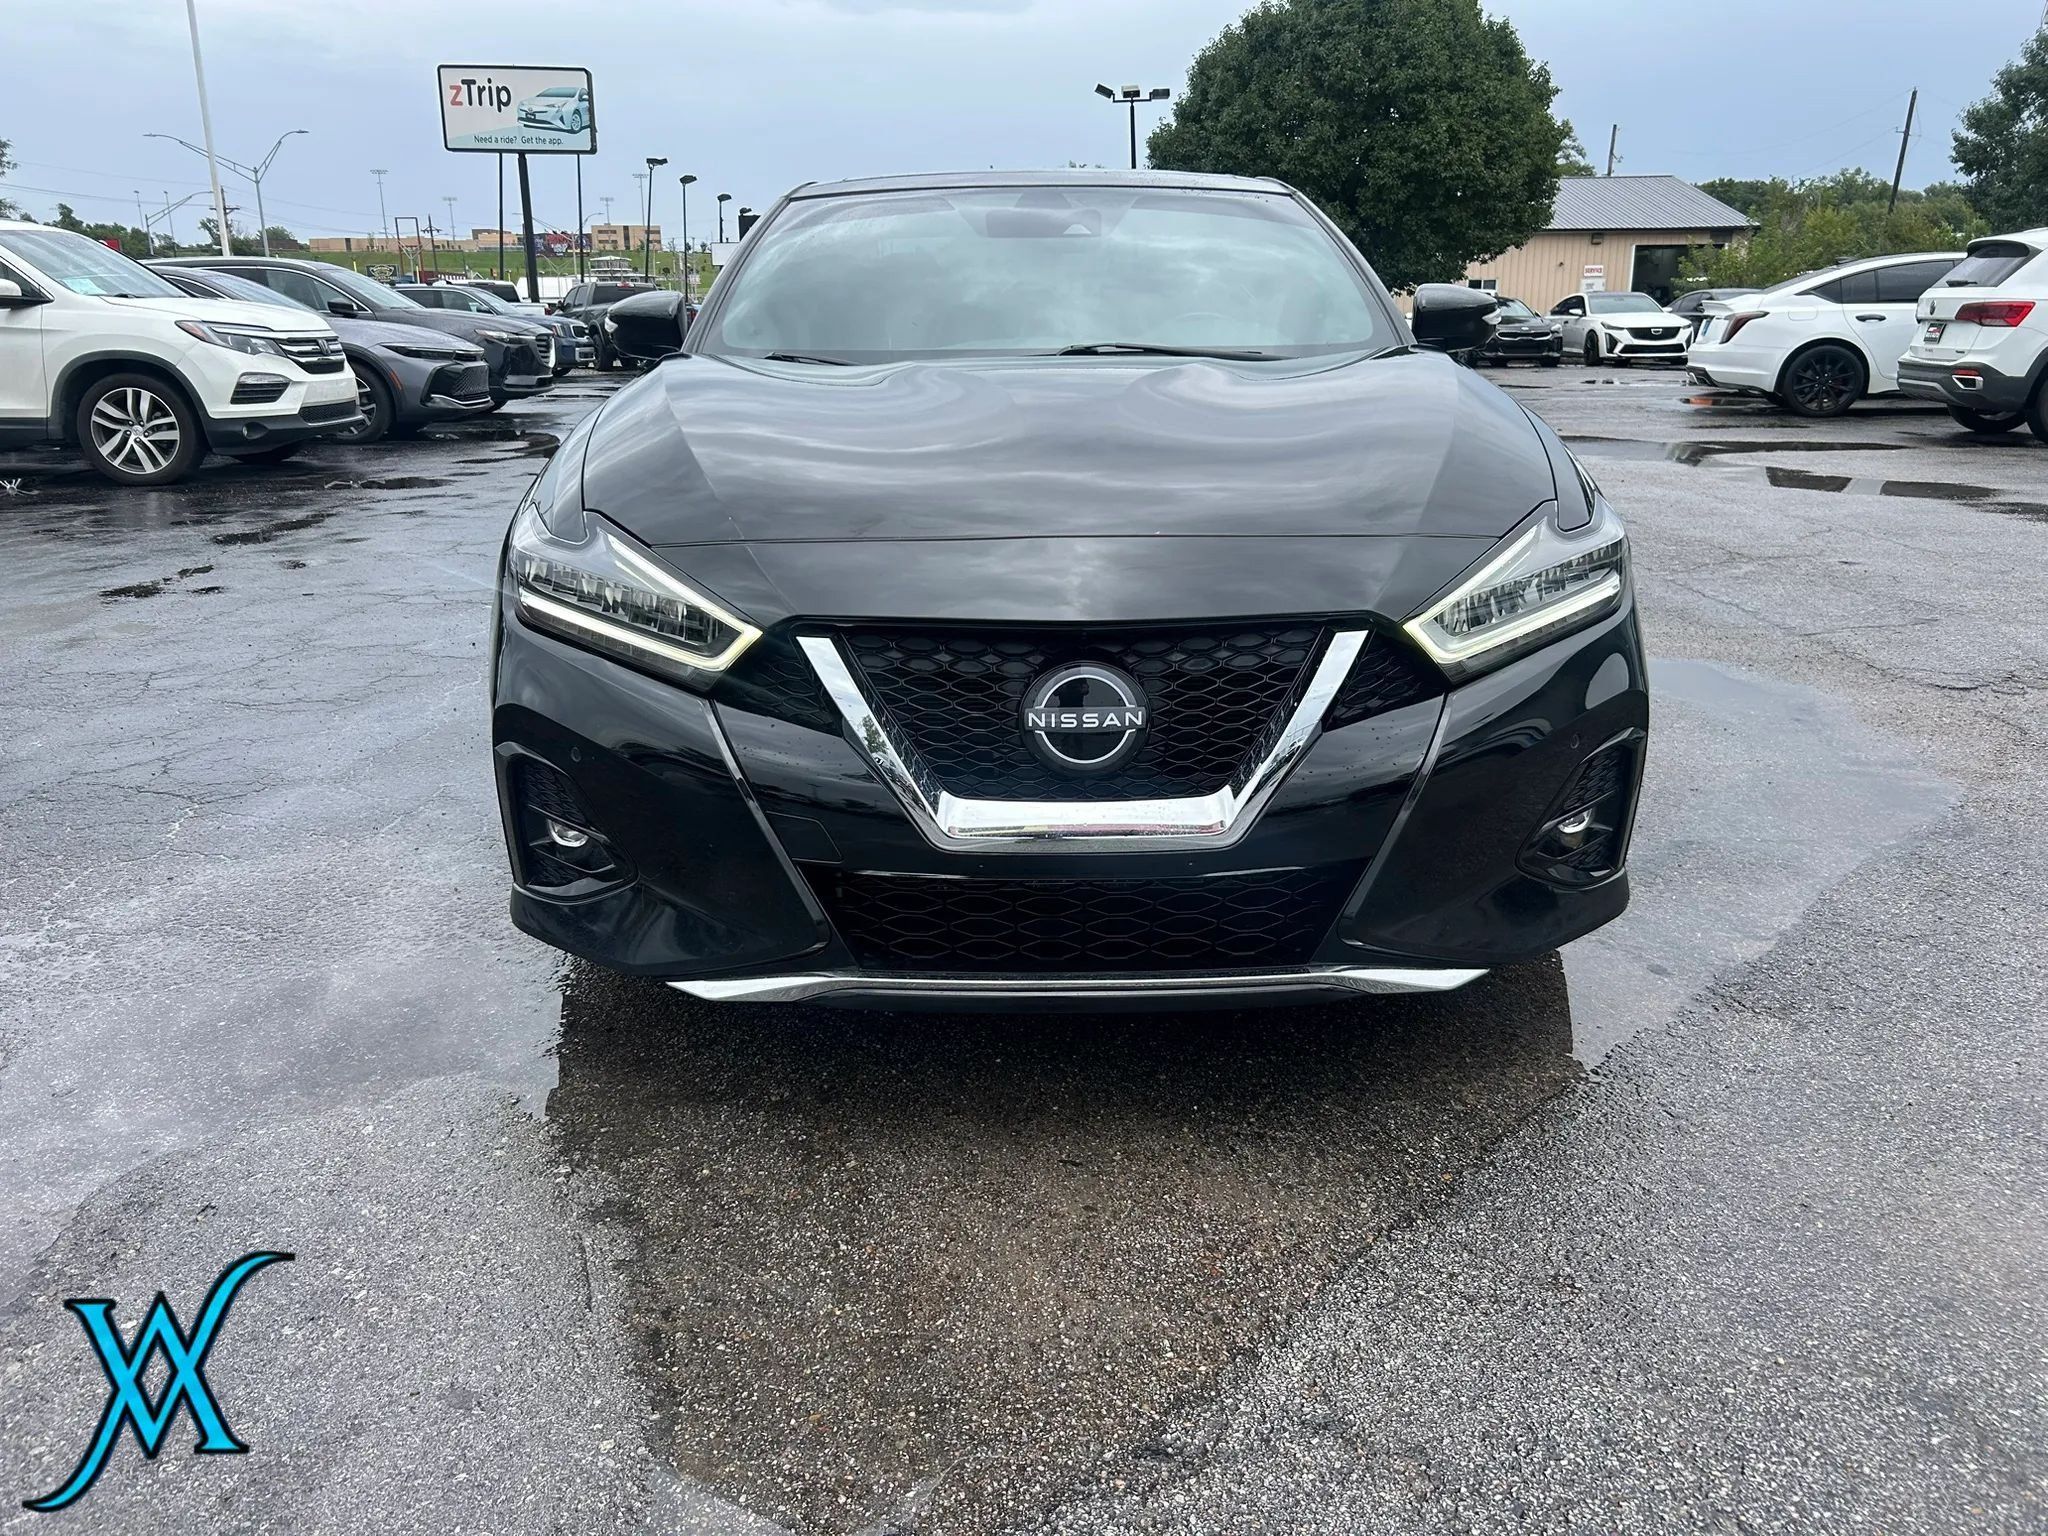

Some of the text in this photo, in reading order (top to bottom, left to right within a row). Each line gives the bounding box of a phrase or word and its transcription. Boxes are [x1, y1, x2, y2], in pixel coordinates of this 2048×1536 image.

[449, 77, 512, 113] zTrip
[474, 135, 493, 144] Need
[500, 135, 518, 144] ride?
[521, 136, 534, 144] Get
[535, 136, 546, 145] the
[548, 138, 564, 147] app.
[1028, 711, 1142, 728] NISSAN
